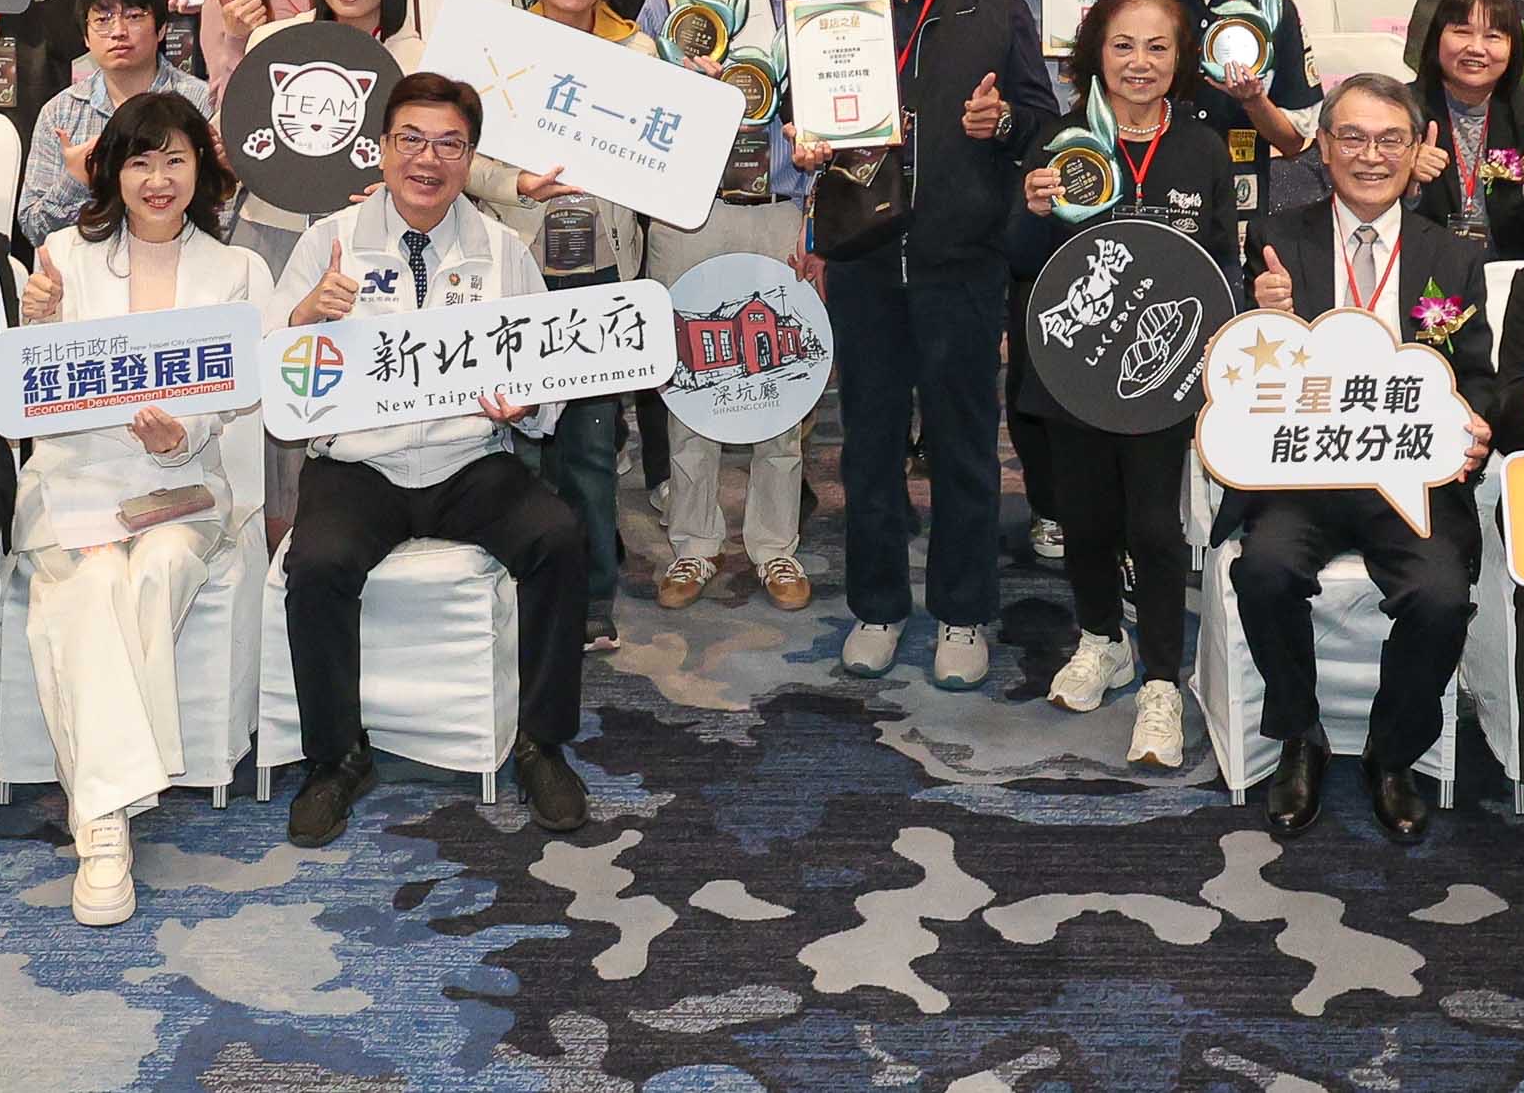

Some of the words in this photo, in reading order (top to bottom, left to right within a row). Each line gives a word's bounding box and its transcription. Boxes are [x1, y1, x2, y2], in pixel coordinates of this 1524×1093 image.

[280, 93, 358, 117] TEAM
[545, 72, 683, 153] 在一起
[537, 117, 567, 138] ONE
[573, 129, 582, 142] &
[589, 136, 668, 174] TOGETHER
[1037, 238, 1135, 349] 食客稻
[21, 333, 129, 367] 新北市政府
[367, 294, 647, 387] 新北市政府
[23, 342, 234, 405] 經濟發展局
[27, 399, 85, 417] Economic
[86, 389, 164, 410] Development
[165, 381, 233, 400] Department
[376, 397, 417, 414] New
[424, 385, 486, 407] Taipei
[494, 381, 534, 398] City
[542, 363, 657, 390] Government
[1249, 374, 1424, 414] 三星典範
[1271, 423, 1434, 463] 能效分級
